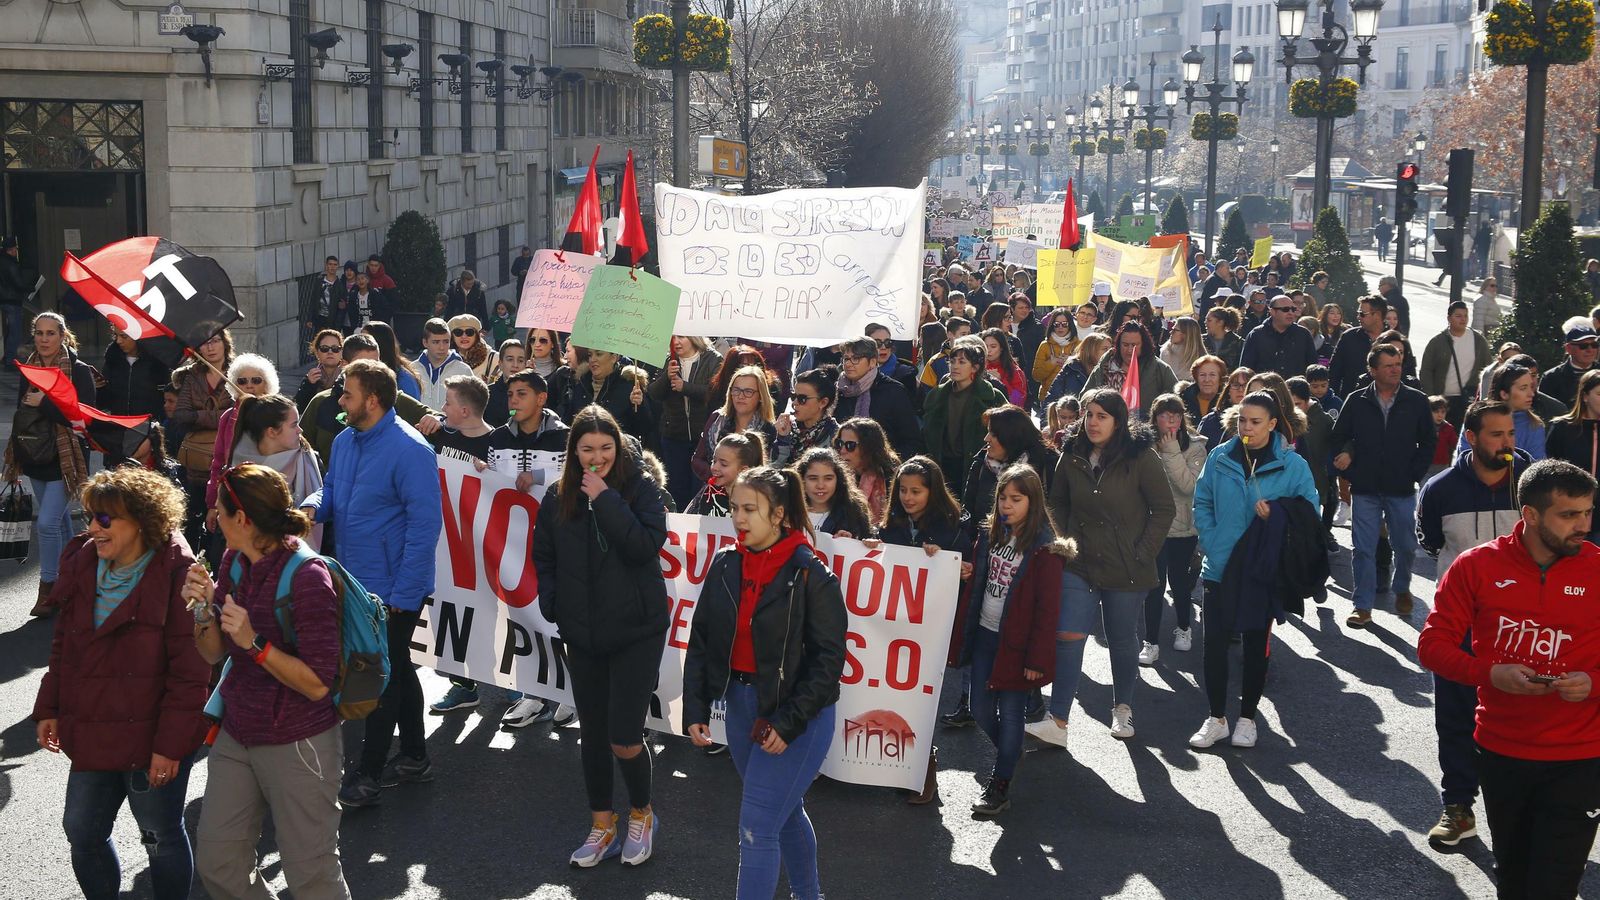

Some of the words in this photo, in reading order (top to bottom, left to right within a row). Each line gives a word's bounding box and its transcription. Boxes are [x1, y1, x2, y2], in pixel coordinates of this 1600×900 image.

[993, 223, 1044, 237] educación
[683, 245, 730, 276] DE
[438, 467, 541, 608] NO
[1563, 585, 1586, 597] ELOY
